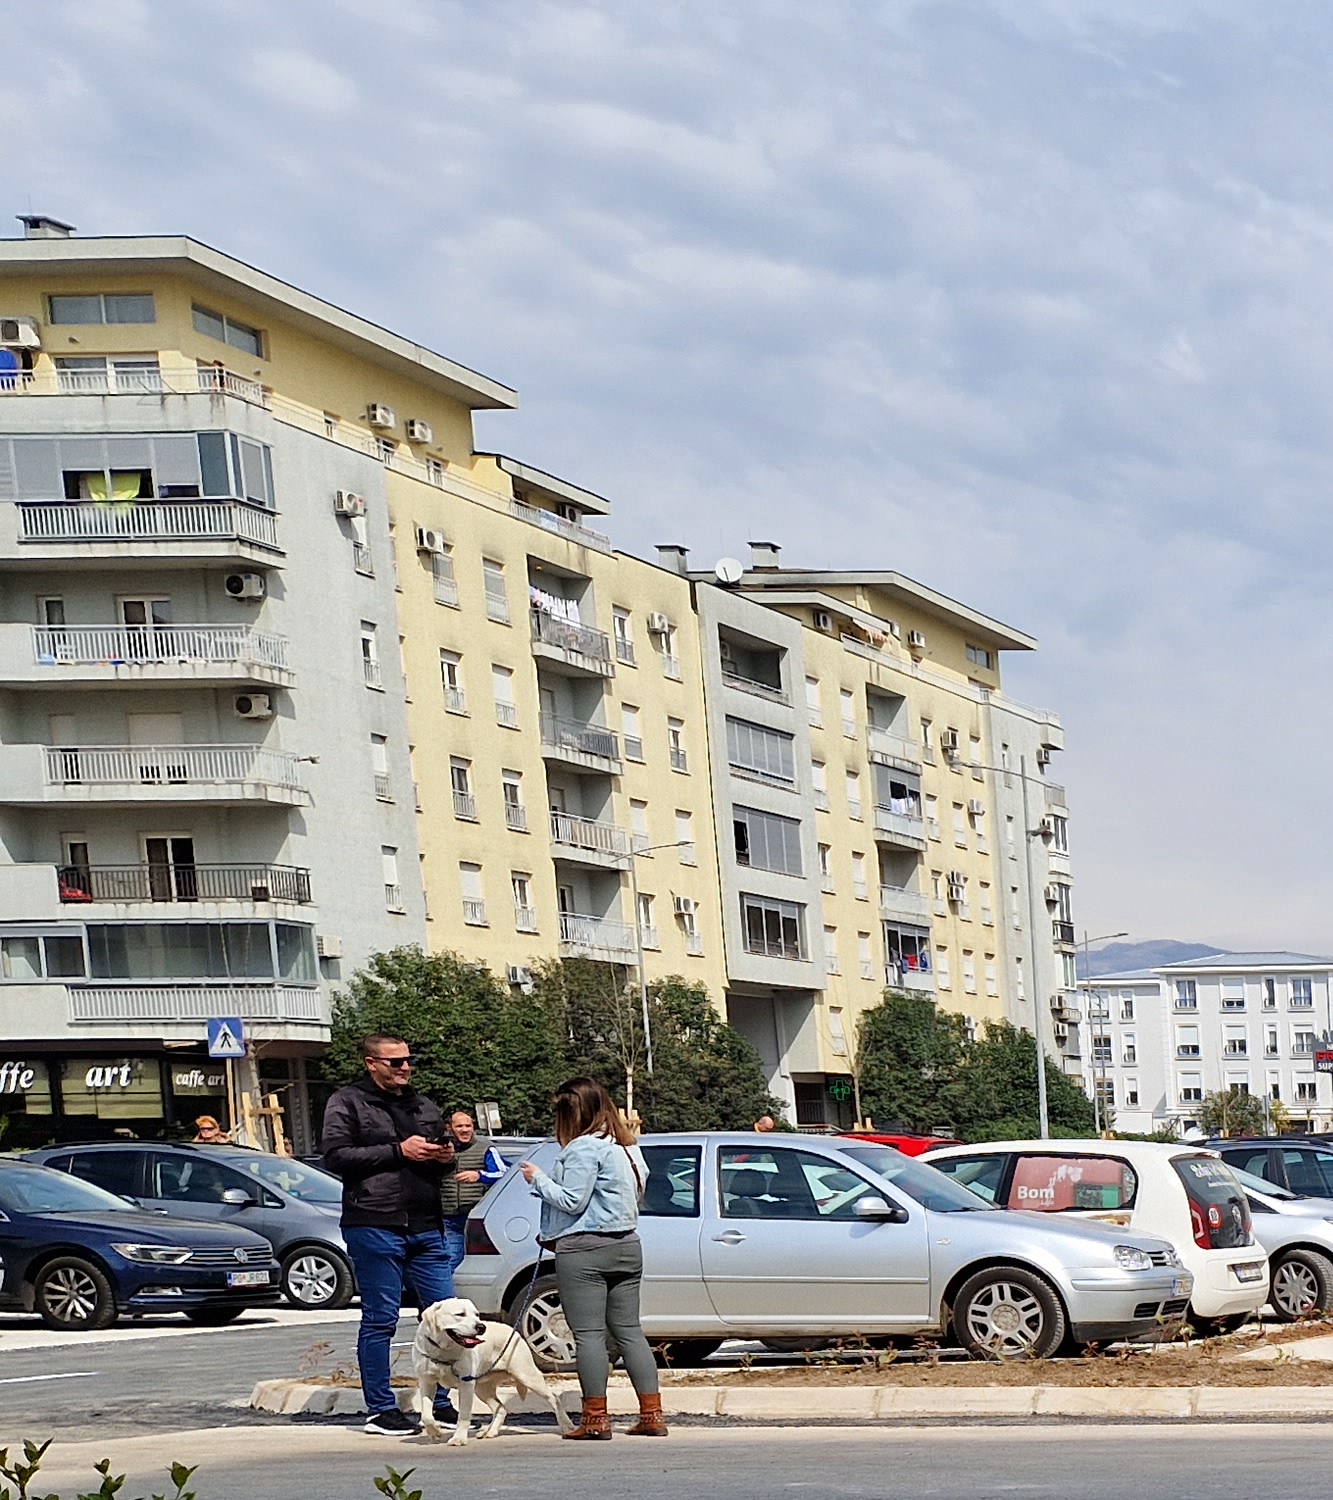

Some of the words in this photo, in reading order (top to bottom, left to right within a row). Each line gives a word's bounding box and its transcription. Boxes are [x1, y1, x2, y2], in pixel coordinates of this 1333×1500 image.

[85, 1061, 131, 1087] art
[175, 1069, 205, 1087] caffe
[208, 1071, 225, 1086] art
[1017, 1185, 1055, 1200] Bom
